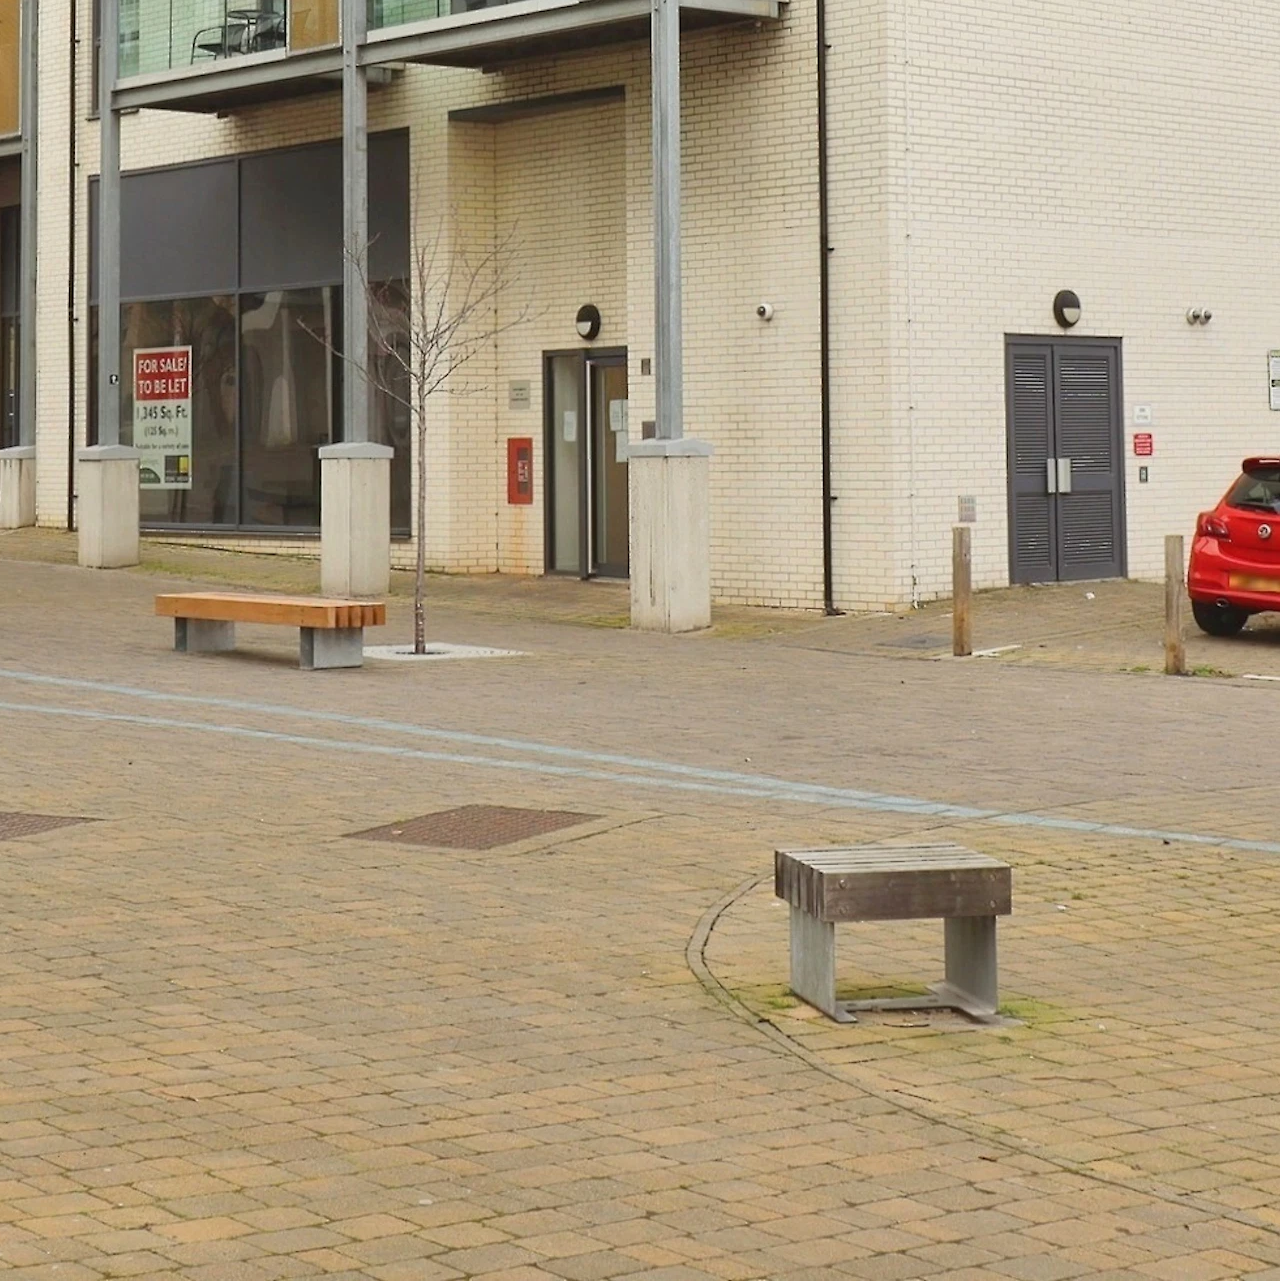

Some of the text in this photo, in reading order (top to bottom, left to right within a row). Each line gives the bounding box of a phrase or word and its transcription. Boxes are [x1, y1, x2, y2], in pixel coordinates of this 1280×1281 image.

[138, 357, 187, 374] FOR SALE/
[138, 377, 187, 394] TO BE LET
[136, 406, 158, 421] 1,345
